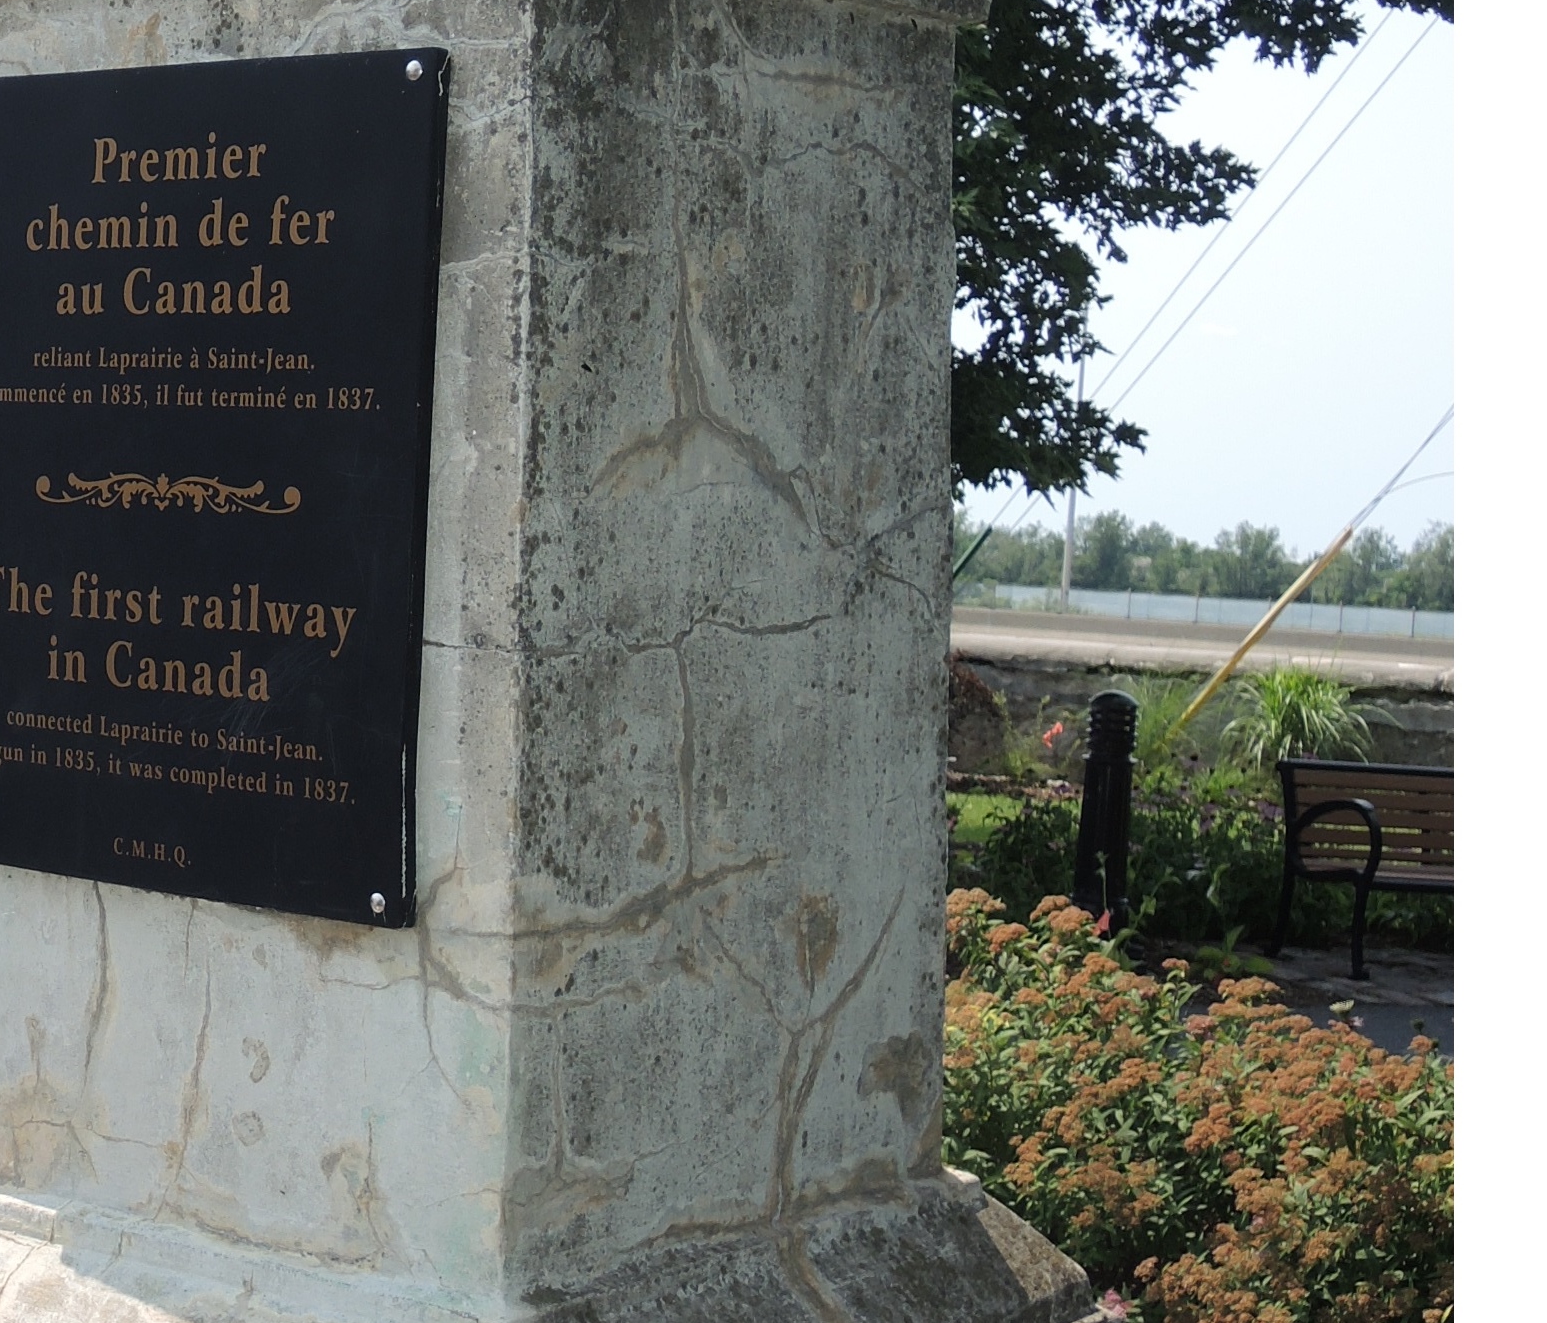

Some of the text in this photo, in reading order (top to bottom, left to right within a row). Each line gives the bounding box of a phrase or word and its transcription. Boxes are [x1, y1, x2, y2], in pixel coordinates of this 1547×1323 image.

[91, 131, 267, 184] Premier
[26, 194, 335, 251] chemin de fer
[56, 264, 291, 315] au Canada
[33, 346, 315, 375] reliant Laprairie à Saint-Jean.
[72, 388, 93, 404] en
[102, 383, 148, 409] 1835,
[155, 384, 169, 406] il
[176, 384, 204, 407] fut
[211, 385, 287, 409] terminé
[294, 392, 317, 409] en
[327, 387, 380, 410] 1837.
[70, 570, 163, 625] first
[181, 583, 357, 657] railway
[47, 634, 271, 702] in Canada
[6, 710, 323, 761] connected Laprairie to Saint-Jean.
[30, 743, 47, 765] in
[56, 747, 101, 774] 1835,
[108, 753, 122, 775] it
[129, 762, 163, 780] was
[169, 766, 267, 794] completed
[275, 773, 293, 797] in
[304, 777, 355, 805] 1837.
[113, 837, 192, 866] C.M.H.Q.
